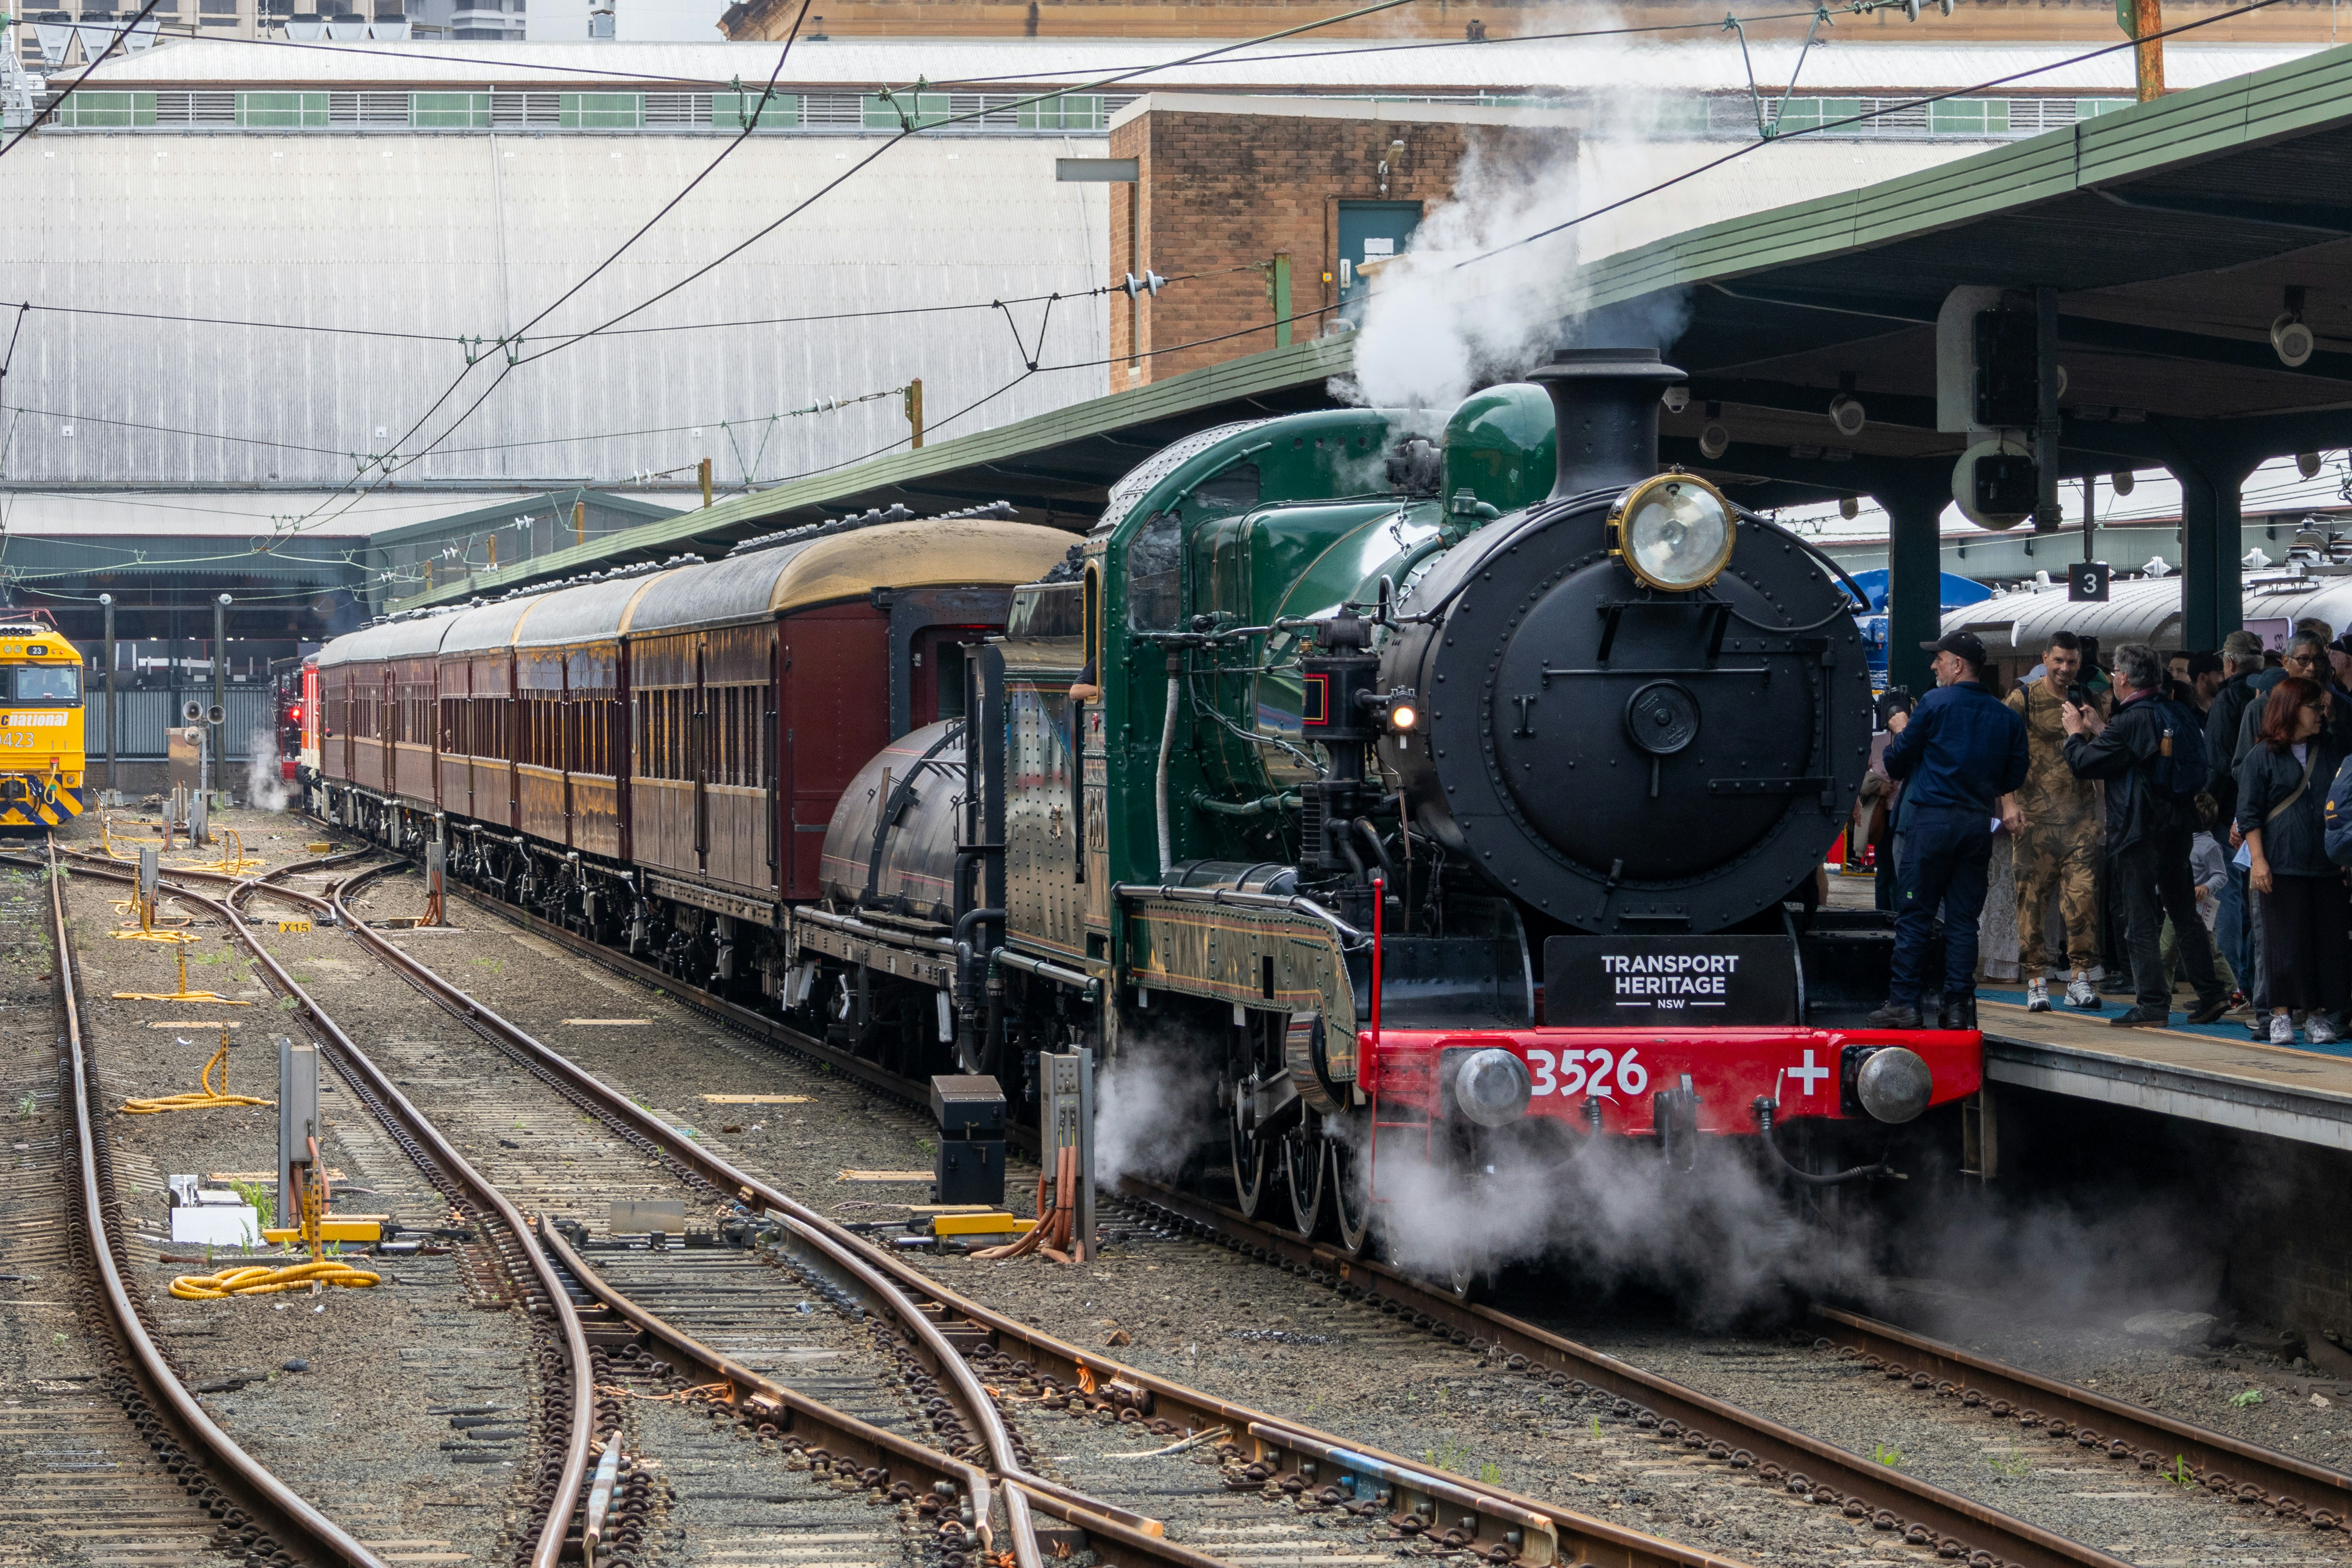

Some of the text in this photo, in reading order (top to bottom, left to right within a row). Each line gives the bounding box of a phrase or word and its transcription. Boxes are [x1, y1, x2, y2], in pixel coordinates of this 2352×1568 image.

[2083, 573, 2097, 594] 3
[284, 923, 309, 933] X15
[1601, 955, 1739, 973] TRANSPORT
[1616, 977, 1725, 994] HERITAGE
[1658, 999, 1685, 1009] NSW
[1527, 1047, 1648, 1096] 3526
